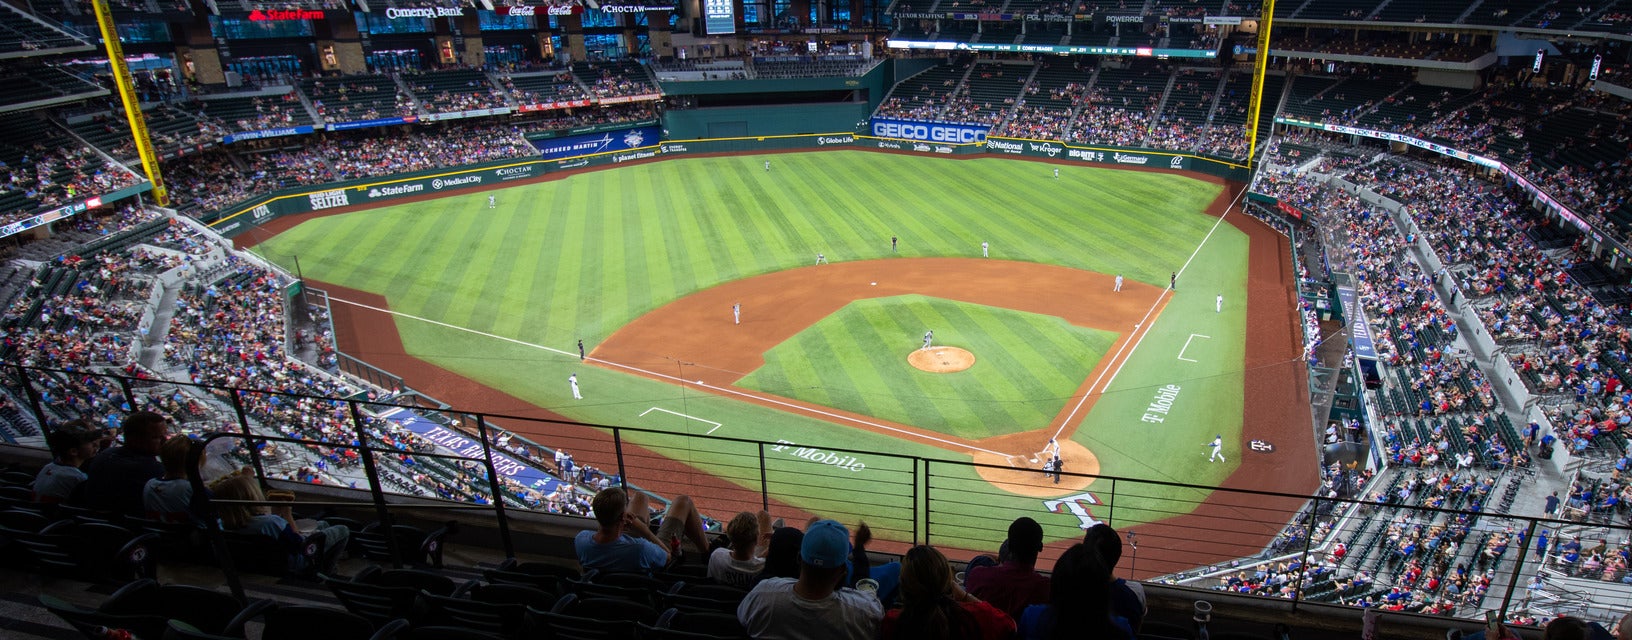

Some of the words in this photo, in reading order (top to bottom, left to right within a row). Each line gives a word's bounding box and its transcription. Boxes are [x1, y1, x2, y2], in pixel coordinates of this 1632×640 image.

[437, 6, 464, 17] Bank
[605, 5, 645, 13] CHOCTAW
[873, 122, 928, 140] GEICO
[931, 126, 986, 143] GEICO
[541, 145, 572, 154] OCKHEED
[573, 142, 598, 151] MARTIN
[1039, 143, 1062, 157] Kroger
[499, 166, 532, 176] CHOCTAW
[443, 177, 468, 187] Medical
[468, 175, 482, 185] City
[310, 194, 350, 210] SELTZER
[253, 204, 270, 218] UTA
[1154, 384, 1181, 416] Mobile
[421, 426, 464, 454] TEXAS
[464, 441, 527, 477] RAGERS
[790, 445, 866, 473] Mobile
